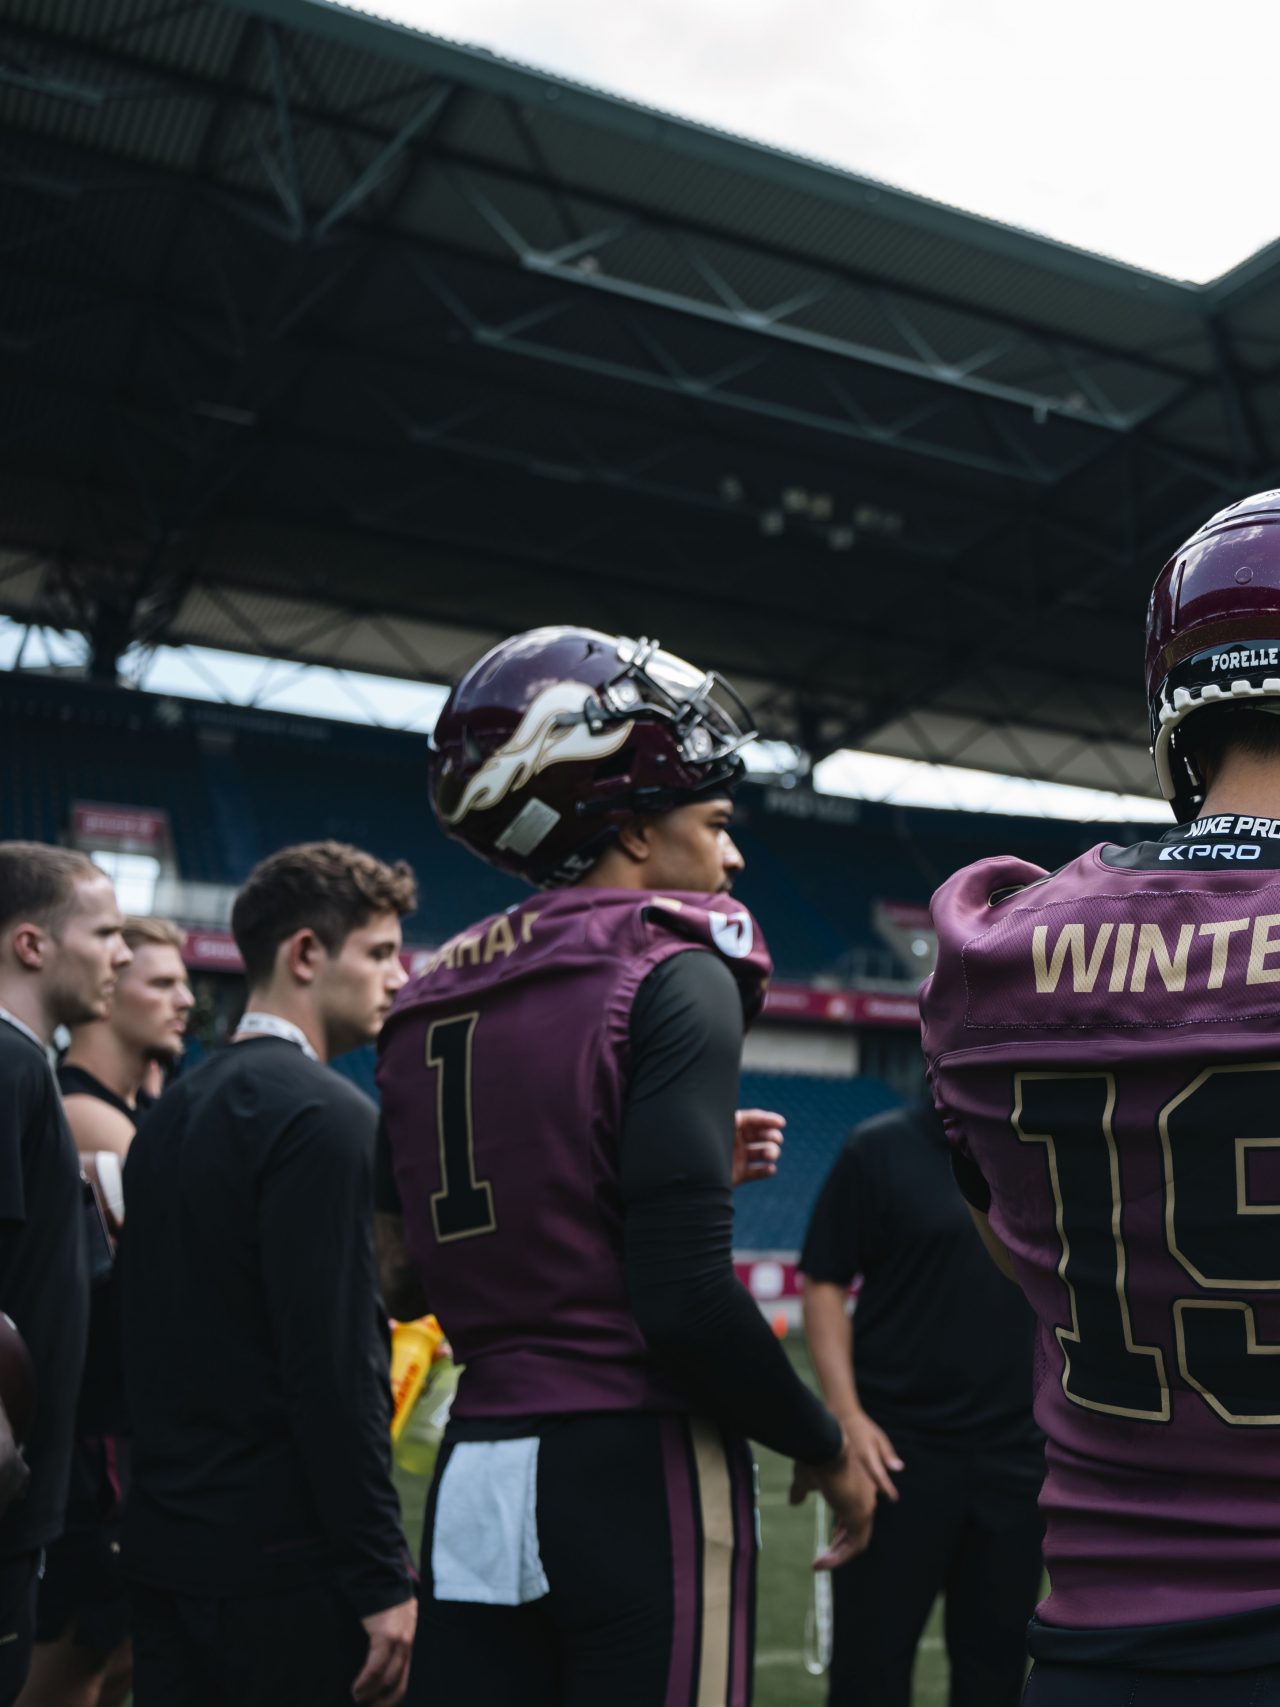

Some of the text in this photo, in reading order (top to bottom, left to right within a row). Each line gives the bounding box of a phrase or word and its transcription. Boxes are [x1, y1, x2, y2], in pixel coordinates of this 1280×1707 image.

[1211, 648, 1279, 671] FORELLE
[1184, 816, 1235, 838] NIKE
[426, 1010, 497, 1244] 1
